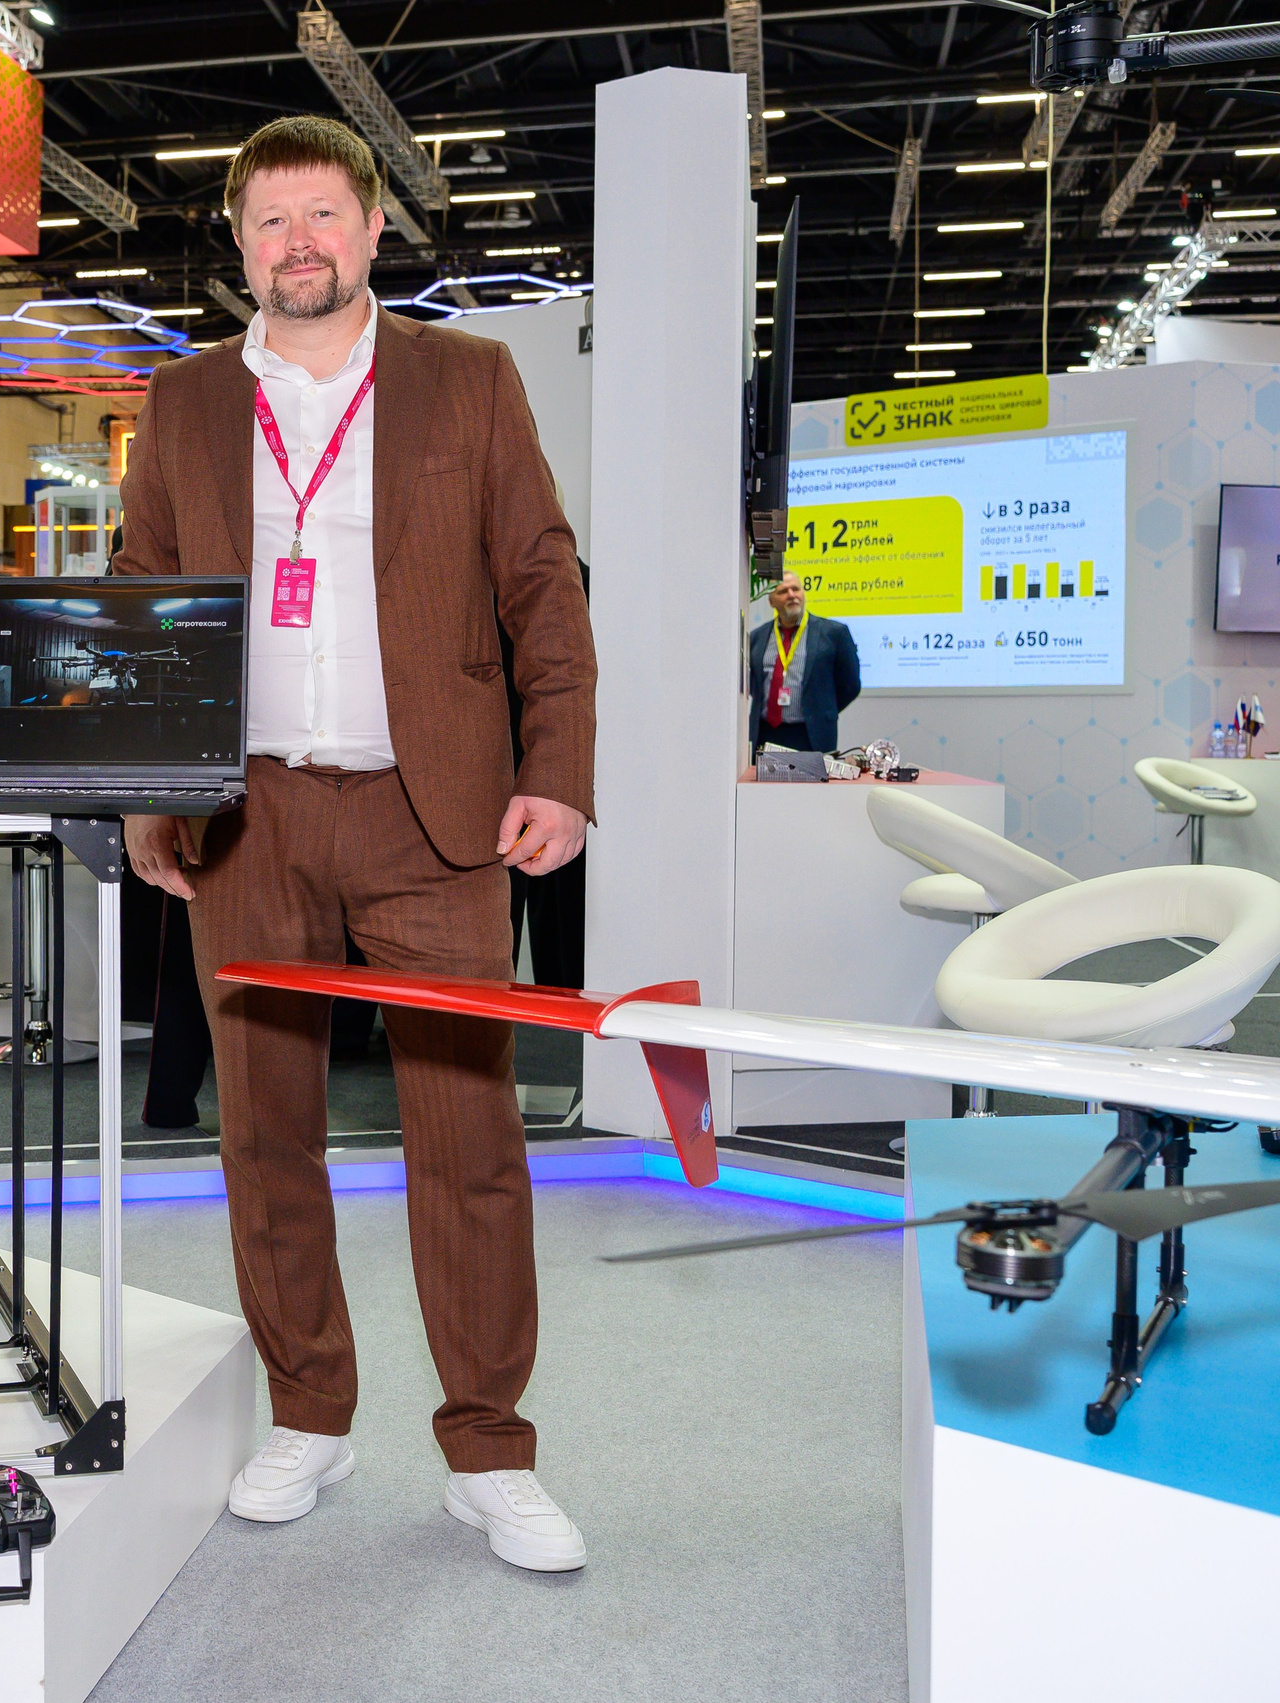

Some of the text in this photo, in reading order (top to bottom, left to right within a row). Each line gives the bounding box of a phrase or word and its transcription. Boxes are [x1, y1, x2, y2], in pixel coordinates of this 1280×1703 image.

[894, 396, 954, 411] ЧЕСТНЫЙ
[894, 411, 953, 431] ЗНАК
[789, 456, 966, 481] ффекты государственной системы
[834, 478, 896, 492] маркировки
[1014, 500, 1023, 516] 3
[1029, 500, 1070, 519] раза
[851, 519, 879, 531] трлн
[851, 534, 894, 549] рублей
[828, 582, 857, 593] млрд
[861, 579, 904, 593] рублей
[923, 633, 954, 650] 122
[957, 640, 985, 654] раза
[1015, 631, 1083, 647] 650 тонн
